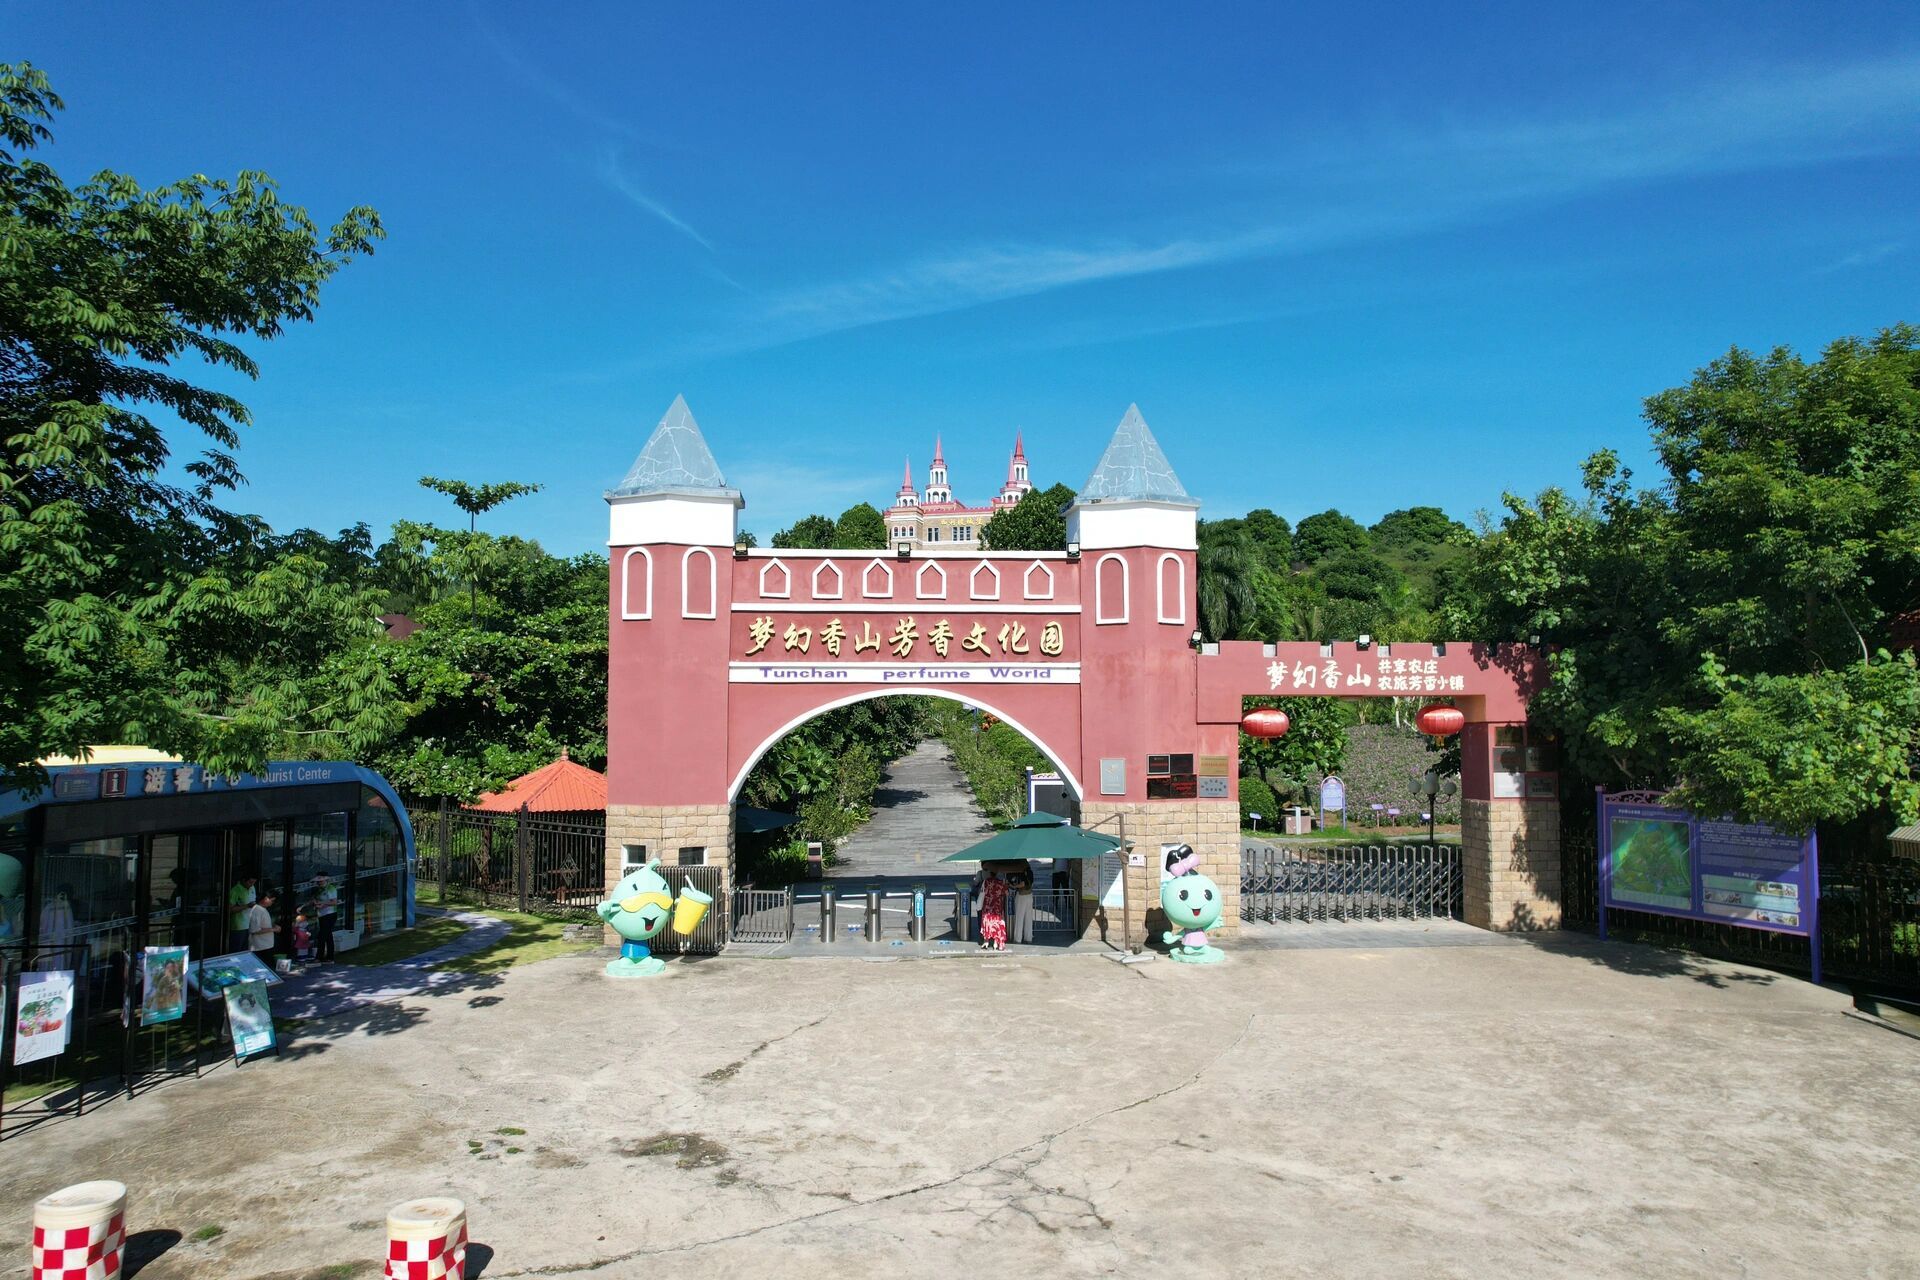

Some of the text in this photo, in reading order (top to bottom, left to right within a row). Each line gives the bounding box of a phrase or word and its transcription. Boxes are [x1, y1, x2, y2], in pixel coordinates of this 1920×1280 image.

[745, 615, 1064, 657] 梦幻香山芳香文化园
[759, 667, 1051, 681] Tunchan perfume World
[1378, 658, 1438, 674] 共享农庄
[1266, 660, 1372, 690] 梦幻香山
[297, 766, 332, 781] Center
